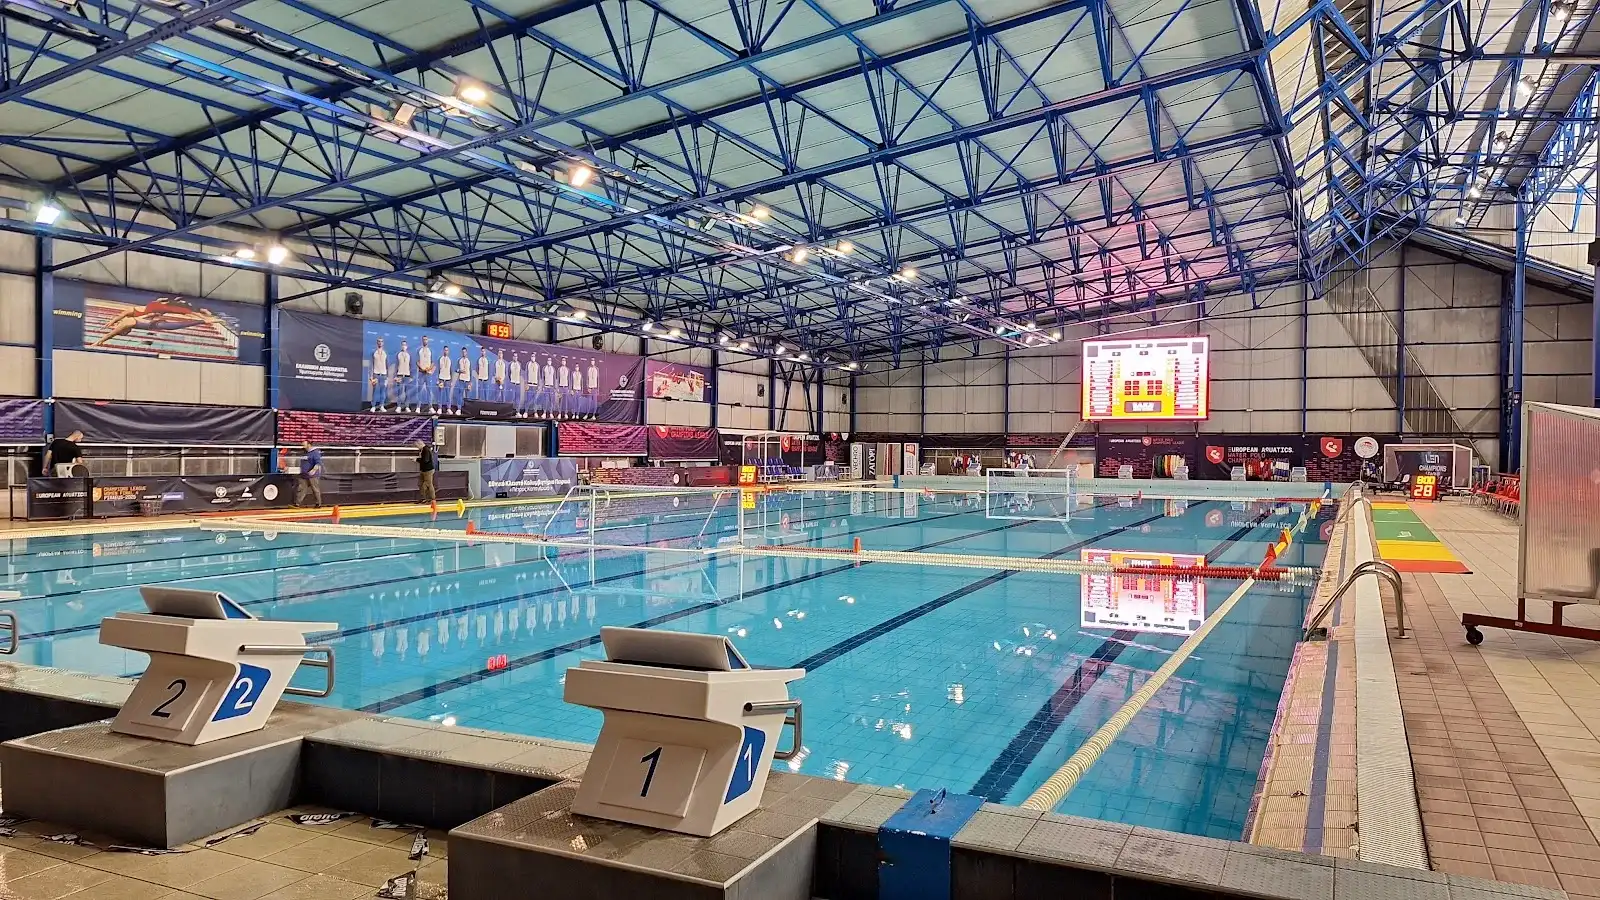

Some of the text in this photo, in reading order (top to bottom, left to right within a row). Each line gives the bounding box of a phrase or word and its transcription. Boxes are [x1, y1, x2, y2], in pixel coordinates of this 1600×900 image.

[53, 309, 82, 319] wimming
[1414, 485, 1433, 496] 28
[151, 678, 187, 719] 2
[234, 677, 253, 710] 2
[640, 746, 663, 798] 1
[743, 743, 752, 782] 1
